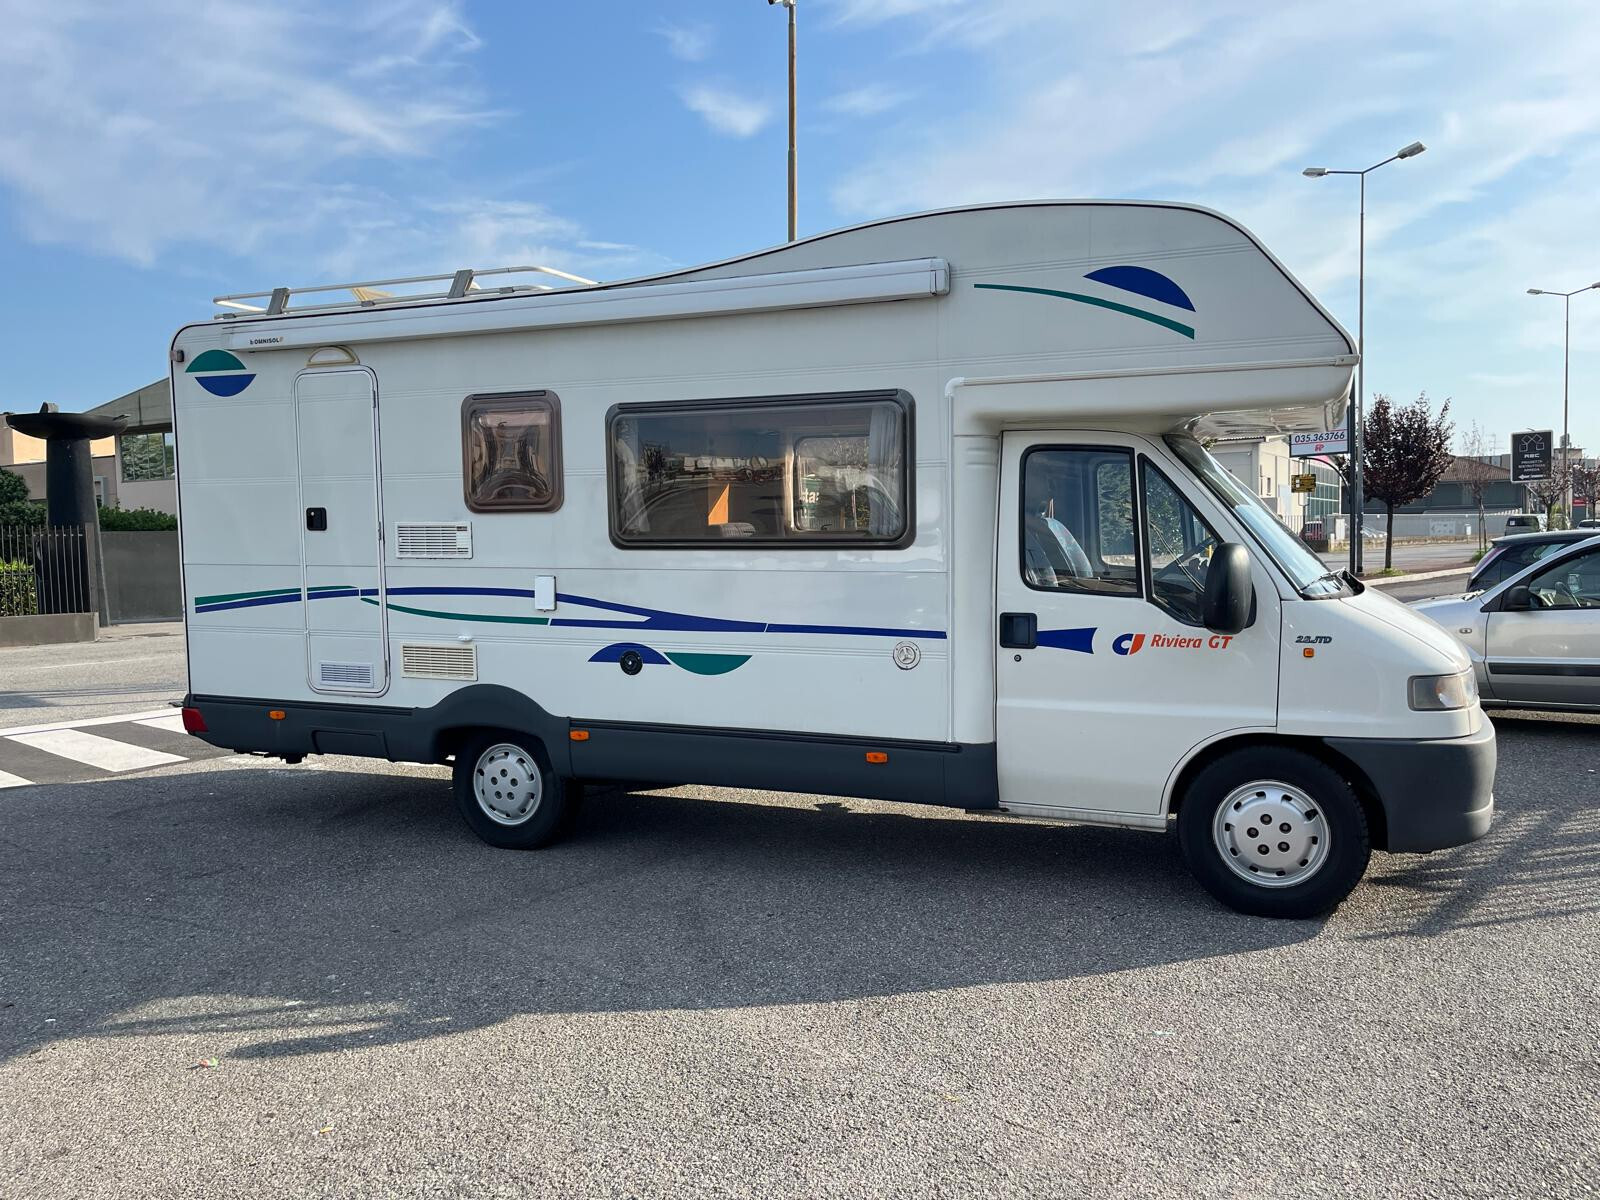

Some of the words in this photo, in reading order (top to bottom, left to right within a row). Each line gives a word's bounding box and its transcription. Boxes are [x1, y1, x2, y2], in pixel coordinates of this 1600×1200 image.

[1294, 432, 1345, 443] 035.363766
[1151, 634, 1203, 649] Riviera
[1208, 635, 1233, 649] GT
